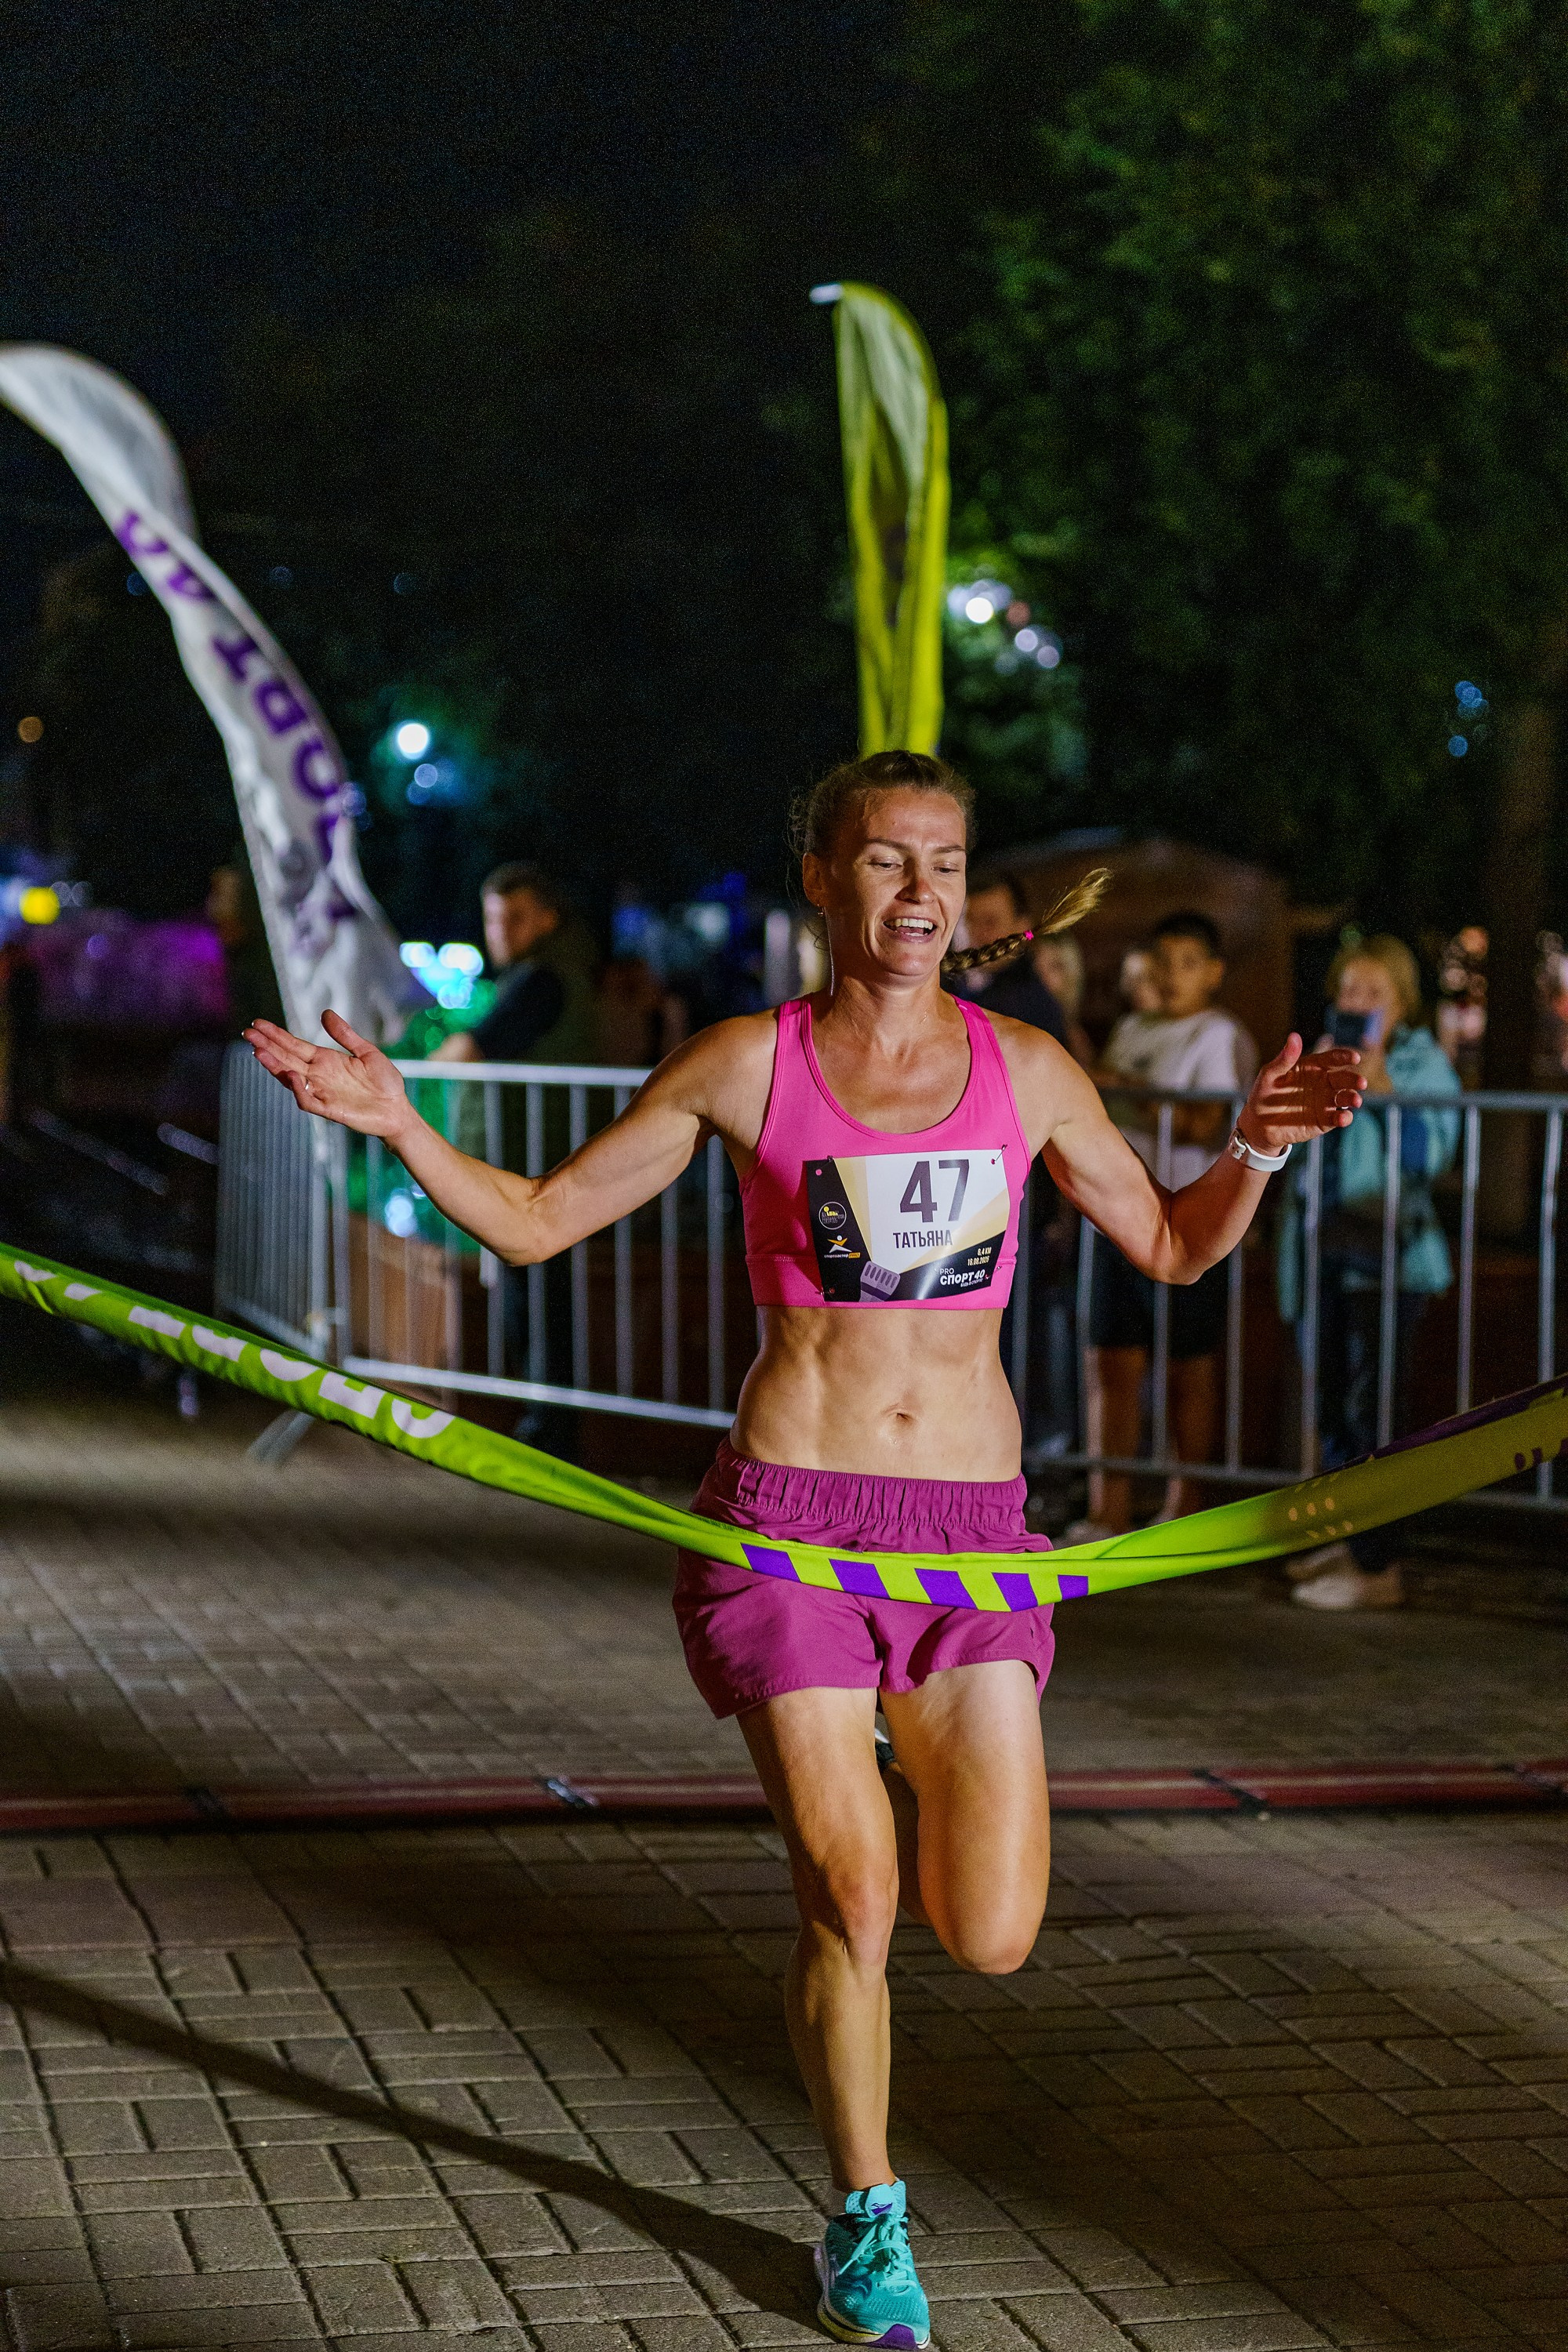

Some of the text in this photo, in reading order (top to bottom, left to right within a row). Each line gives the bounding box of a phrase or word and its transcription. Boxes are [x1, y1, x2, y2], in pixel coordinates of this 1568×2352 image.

[899, 1159, 970, 1223] 47
[892, 1229, 953, 1249] ТАТЬЯНА
[940, 1272, 975, 1286] СПОРТ
[974, 1269, 985, 1279] 40
